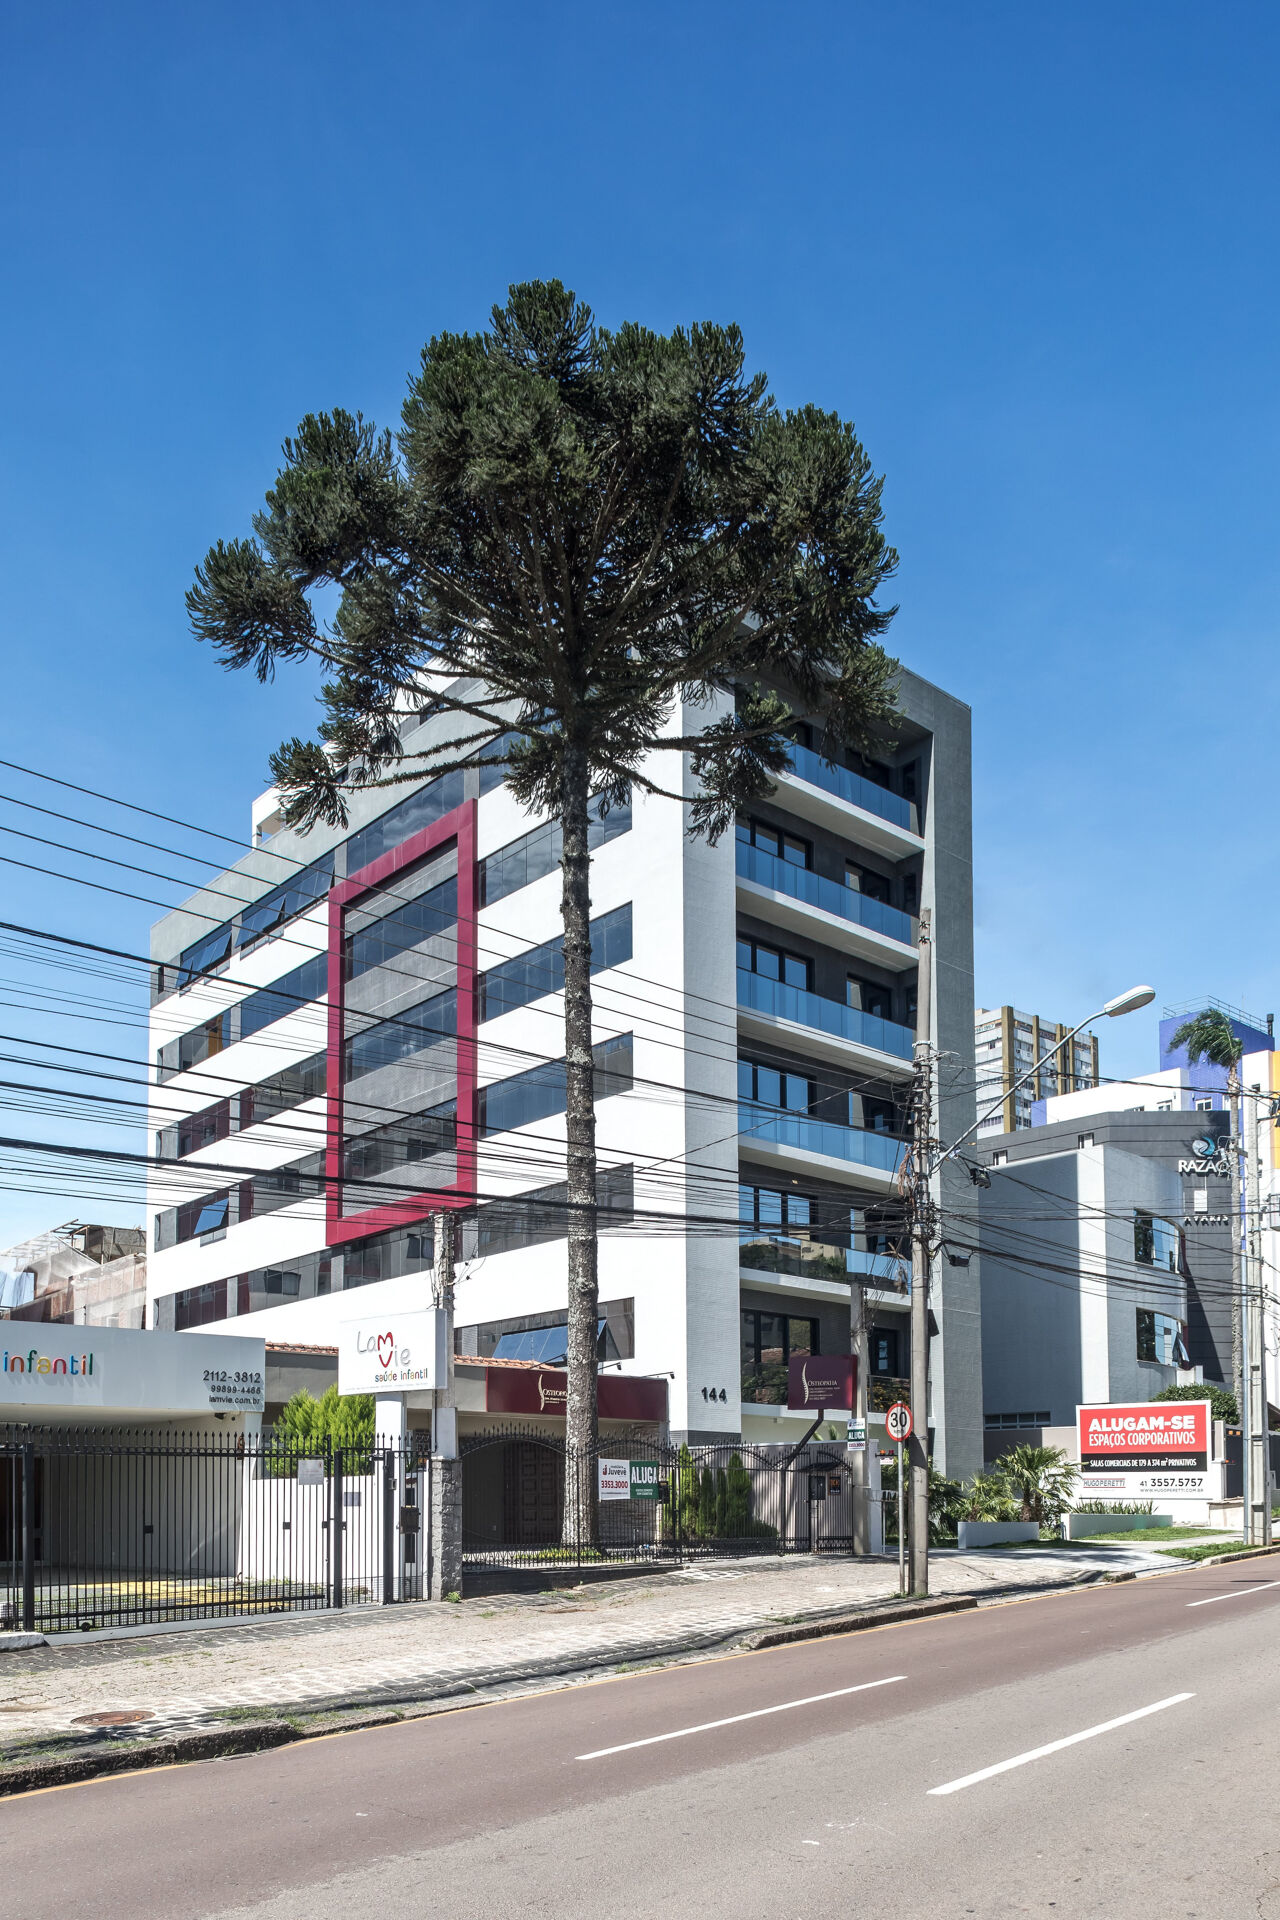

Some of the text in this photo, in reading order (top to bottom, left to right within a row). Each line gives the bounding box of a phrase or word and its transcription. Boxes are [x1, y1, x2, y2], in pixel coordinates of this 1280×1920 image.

[4, 1350, 93, 1375] infantil
[203, 1370, 260, 1383] 2112-3812
[375, 1368, 428, 1382] saúde infantil
[702, 1387, 726, 1401] 144
[890, 1412, 907, 1428] 30
[1088, 1415, 1196, 1432] ALUGAM-SE
[848, 1431, 865, 1440] ALUGA
[1089, 1431, 1196, 1448] ESPAÇOS CORPORATIVOS
[1090, 1459, 1104, 1468] SALAS
[1104, 1459, 1131, 1467] COMERCIAIS
[1131, 1459, 1139, 1467] DE
[1147, 1459, 1152, 1467] A
[1168, 1458, 1197, 1467] PRIVATIVOS
[631, 1466, 658, 1484] ALUGA
[601, 1480, 629, 1489] 3353.3000
[1150, 1478, 1203, 1487] 3557.5757
